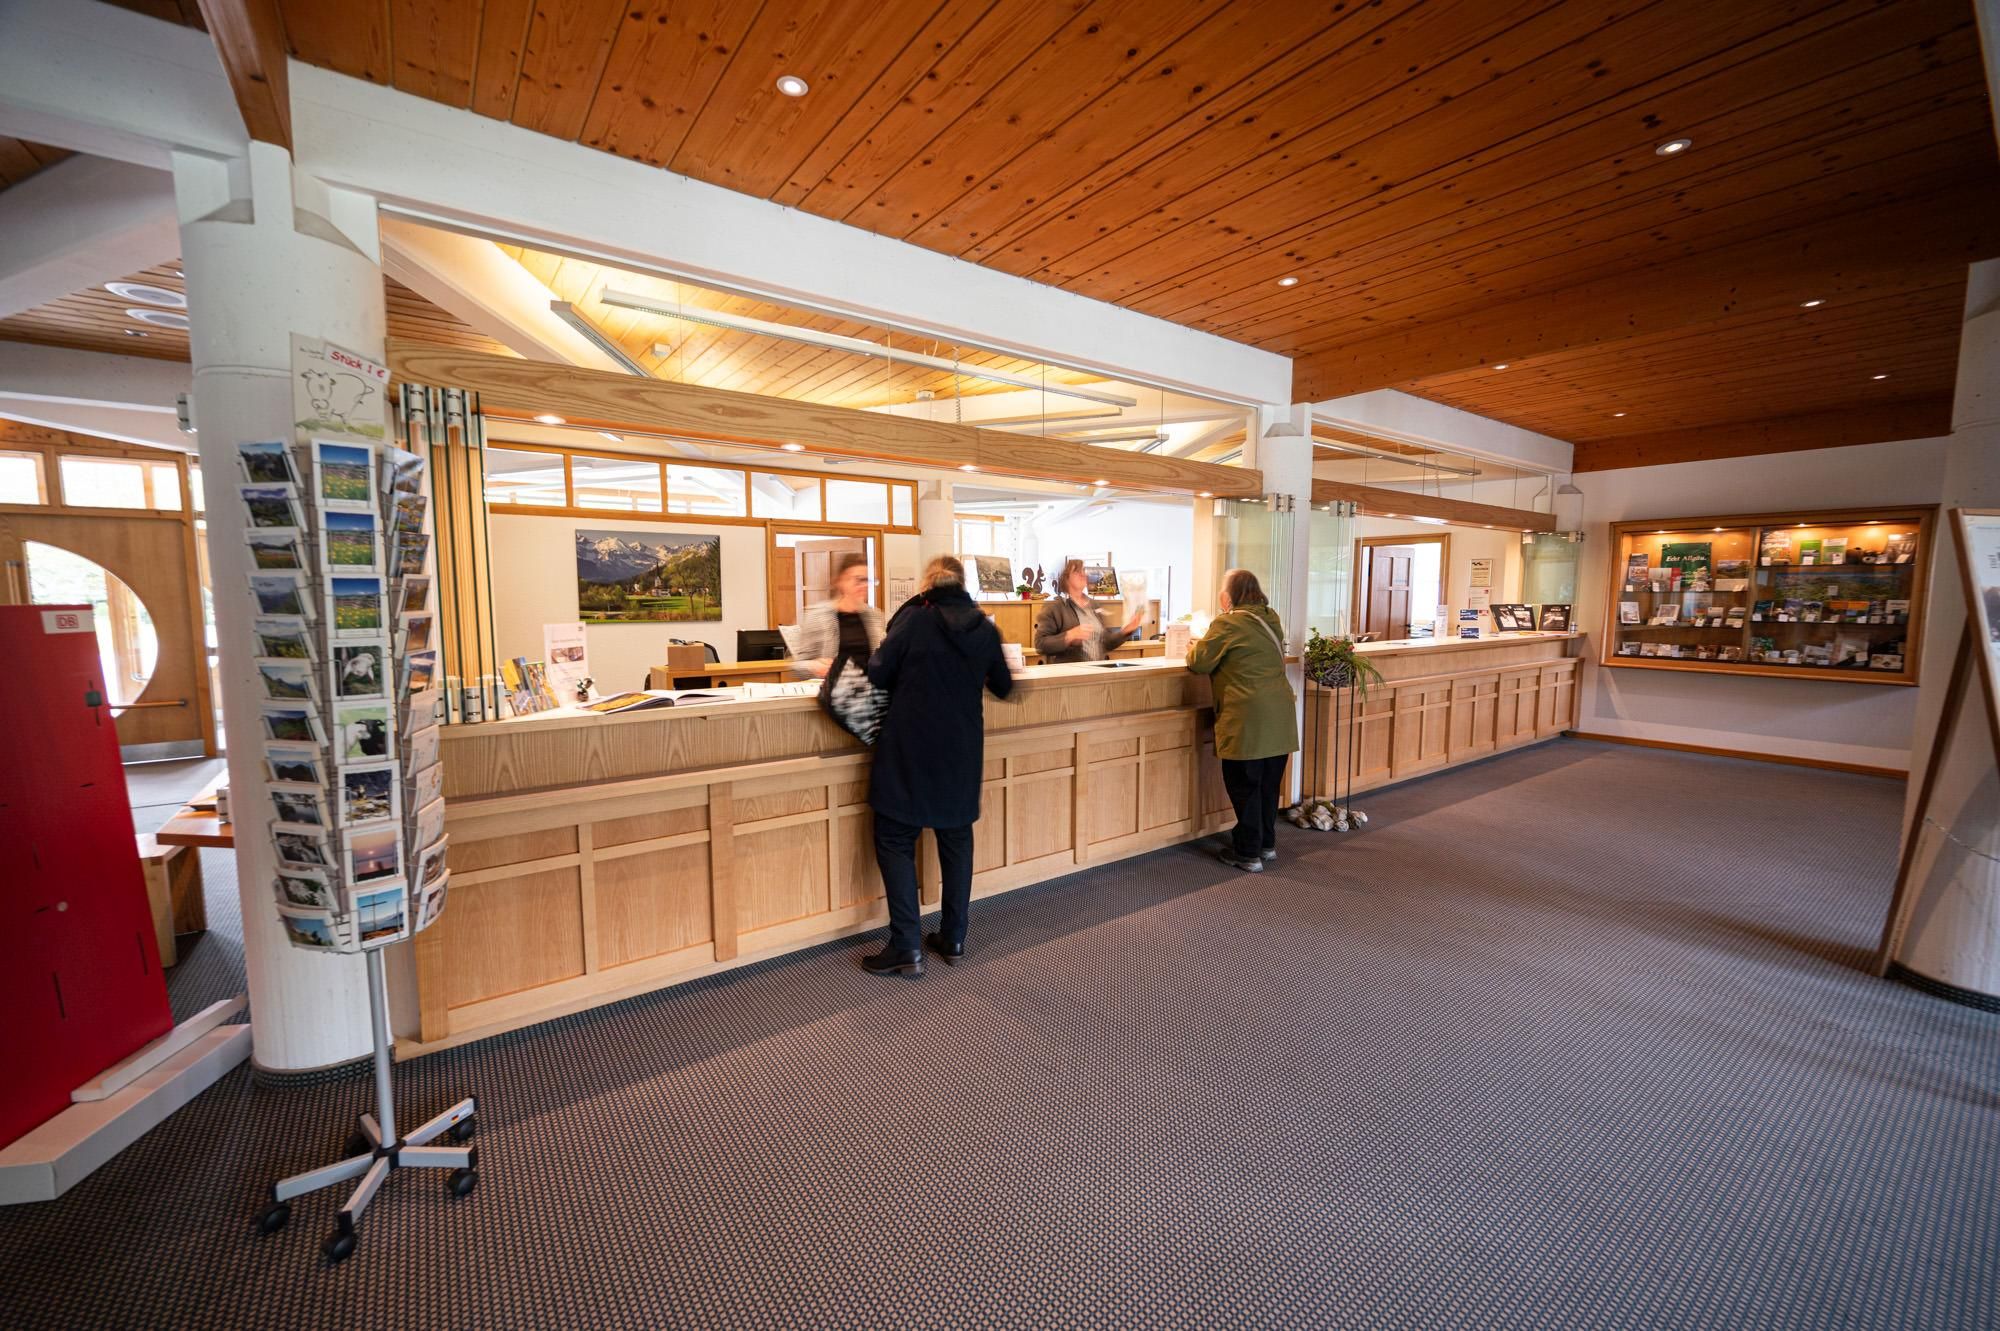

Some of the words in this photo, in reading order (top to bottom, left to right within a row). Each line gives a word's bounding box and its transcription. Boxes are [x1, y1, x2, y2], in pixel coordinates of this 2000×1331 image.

[330, 351, 363, 370] Stück
[367, 365, 373, 374] 1
[376, 369, 385, 378] €
[58, 616, 77, 628] DB
